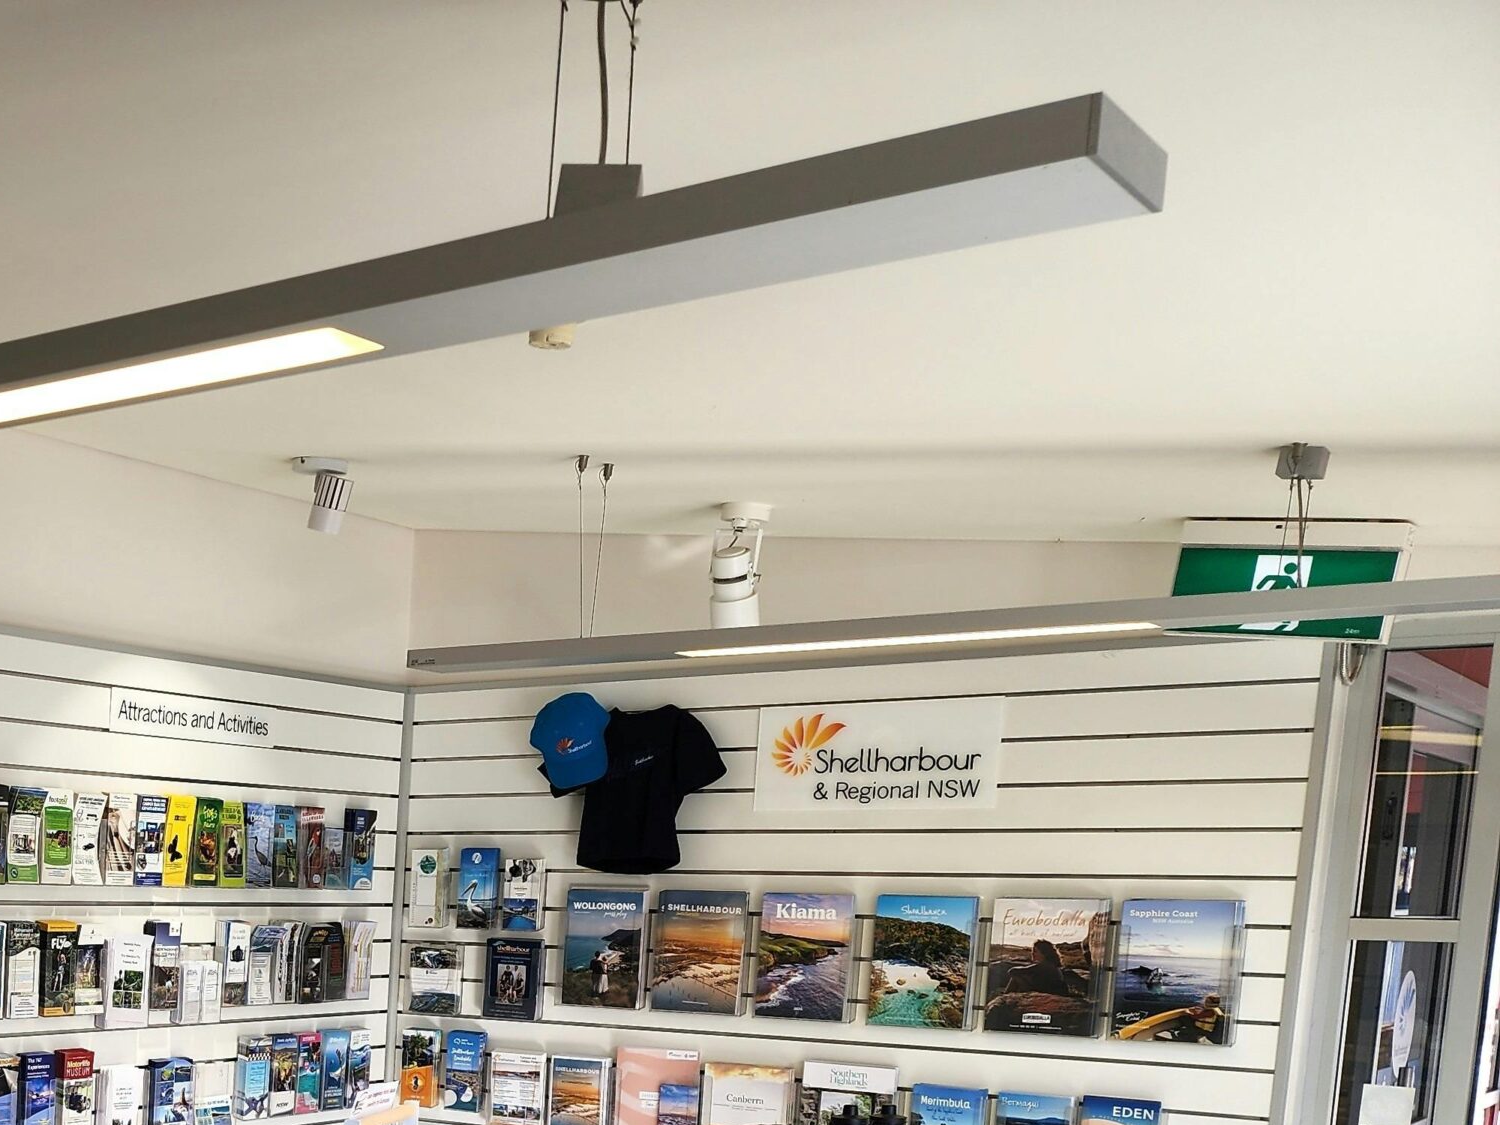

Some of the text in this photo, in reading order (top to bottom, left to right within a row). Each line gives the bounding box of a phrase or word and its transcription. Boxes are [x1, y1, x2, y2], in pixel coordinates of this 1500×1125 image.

[118, 700, 269, 736] Attractions and Activities
[814, 747, 982, 775] Shellharbour
[813, 779, 981, 804] & Regional NSW
[573, 901, 637, 912] WOLLONGONG
[667, 903, 743, 915] SHELLHARBOUR
[776, 903, 837, 920] Kiama
[1003, 908, 1088, 928] Eurobodalla
[1129, 909, 1198, 919] Sapphire Coast
[66, 1068, 91, 1077] MUSEUM
[831, 1068, 868, 1080] Southern
[726, 1093, 765, 1105] Canberra
[920, 1095, 972, 1109] Merimbula
[1112, 1106, 1154, 1120] EDEN
